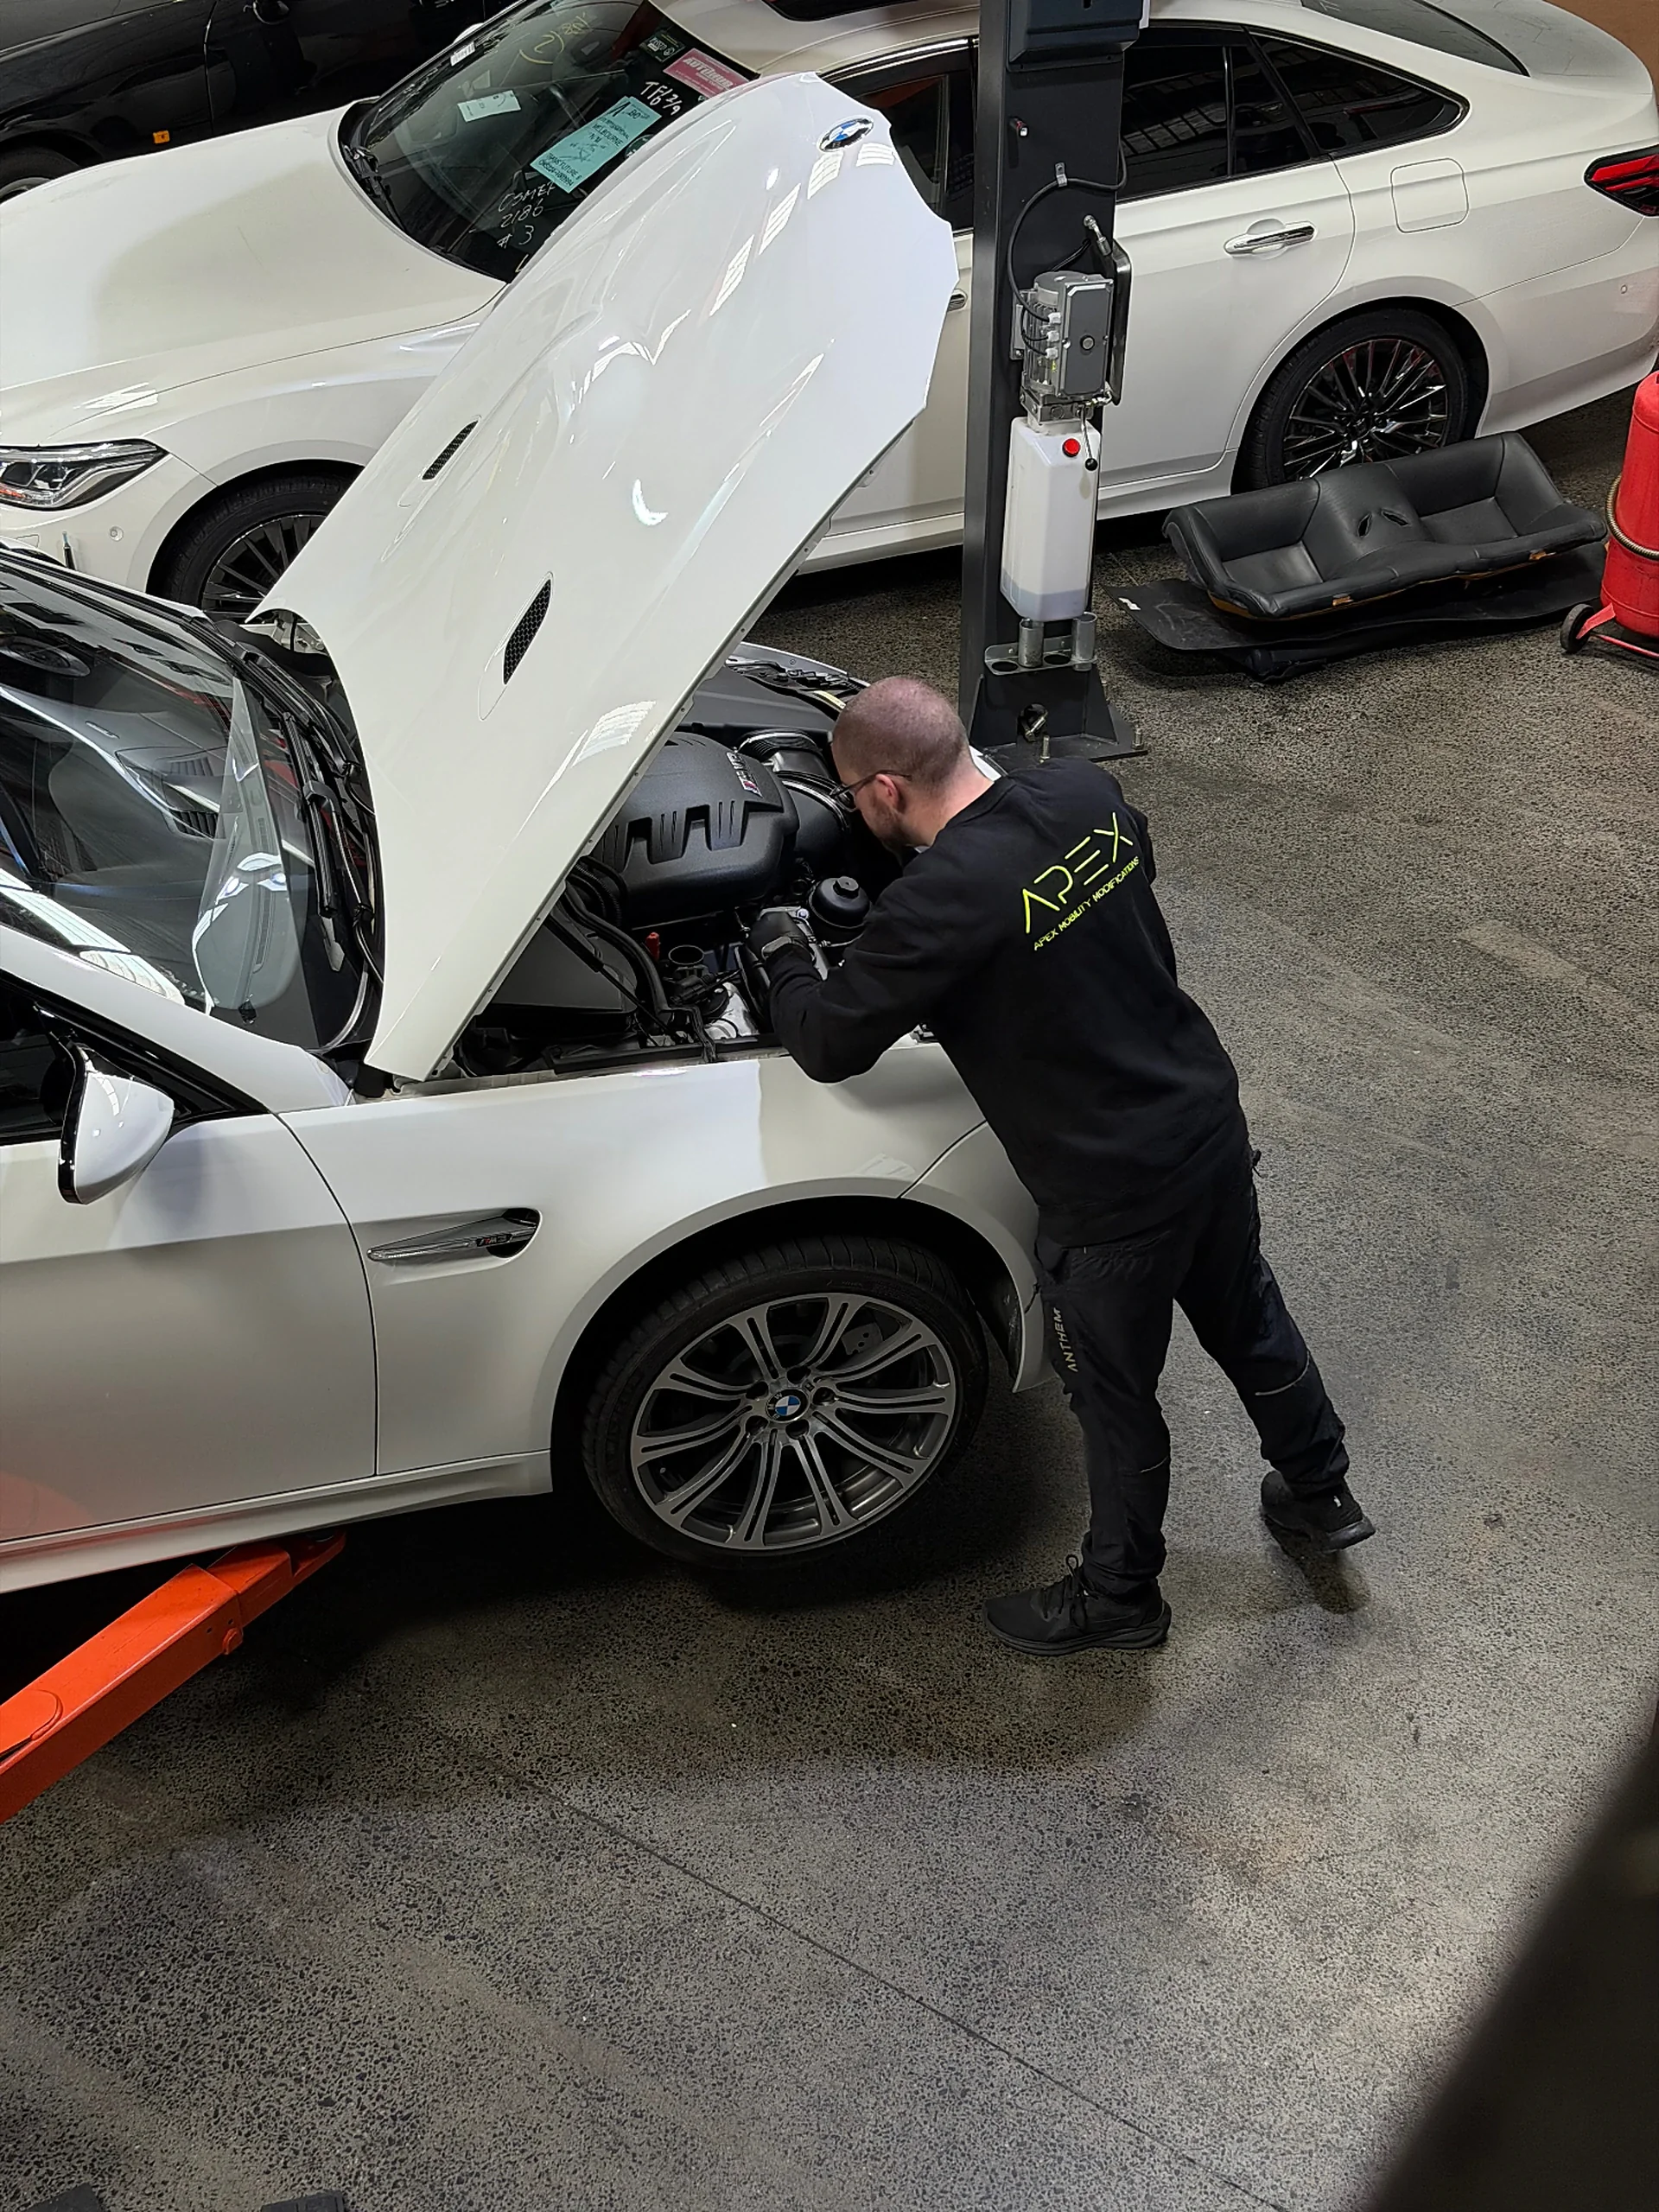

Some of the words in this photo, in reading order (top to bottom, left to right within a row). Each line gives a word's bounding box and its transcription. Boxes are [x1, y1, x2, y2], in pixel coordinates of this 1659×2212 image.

[518, 225, 535, 245] 3
[1022, 811, 1134, 934] APEX
[1033, 928, 1059, 951] APEX
[1058, 898, 1091, 931] MOBILITY
[1091, 855, 1140, 902] MODIFICATIONS
[1052, 1306, 1079, 1373] ANTHEM
